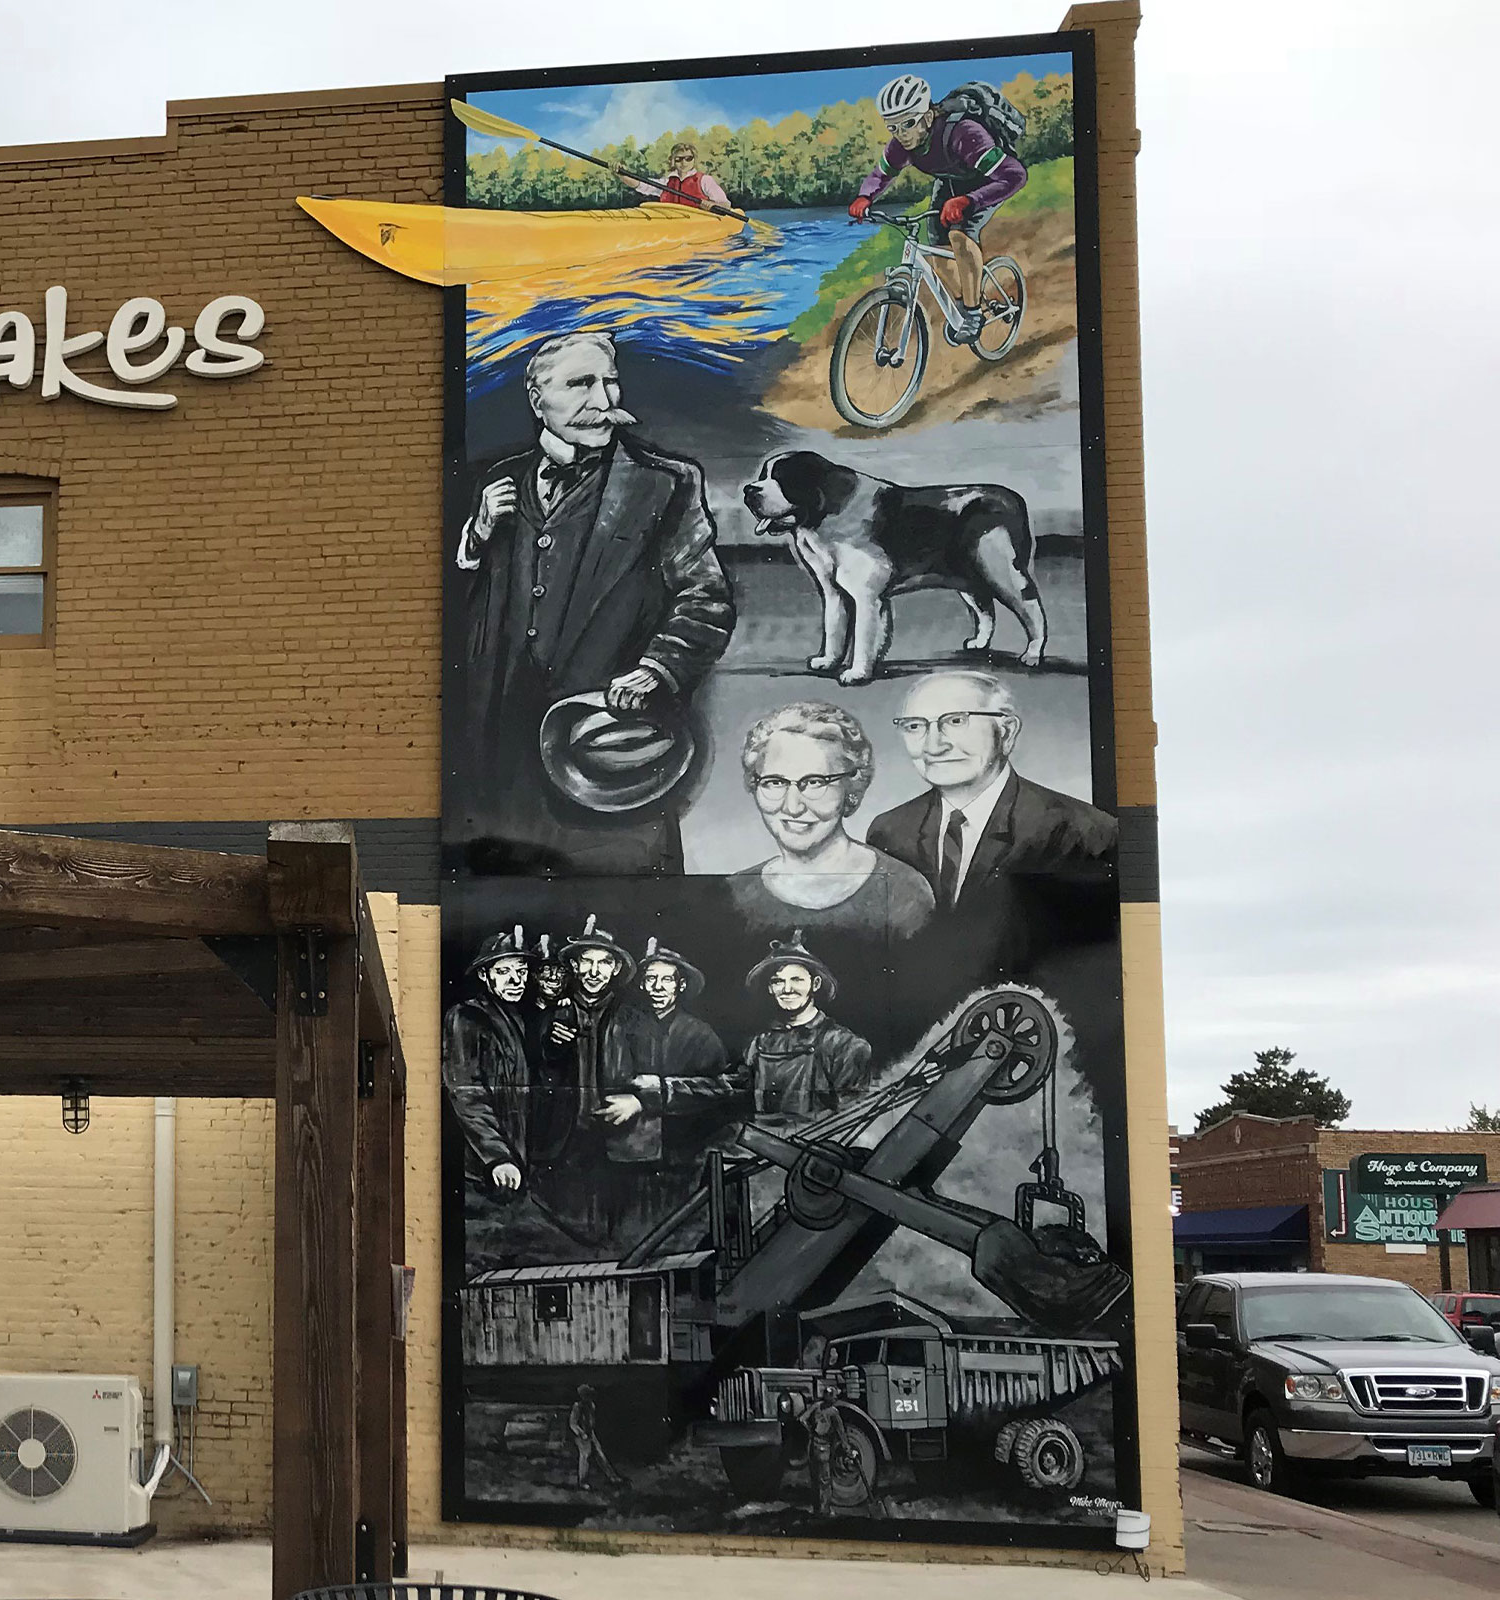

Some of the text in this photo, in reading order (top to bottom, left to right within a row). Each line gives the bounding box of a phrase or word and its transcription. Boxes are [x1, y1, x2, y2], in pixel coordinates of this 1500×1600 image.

[1404, 1161, 1418, 1172] &
[1420, 1160, 1479, 1176] Company
[1385, 1197, 1438, 1208] HOUS
[1355, 1222, 1466, 1242] SPECIALIE
[894, 1399, 919, 1412] 251
